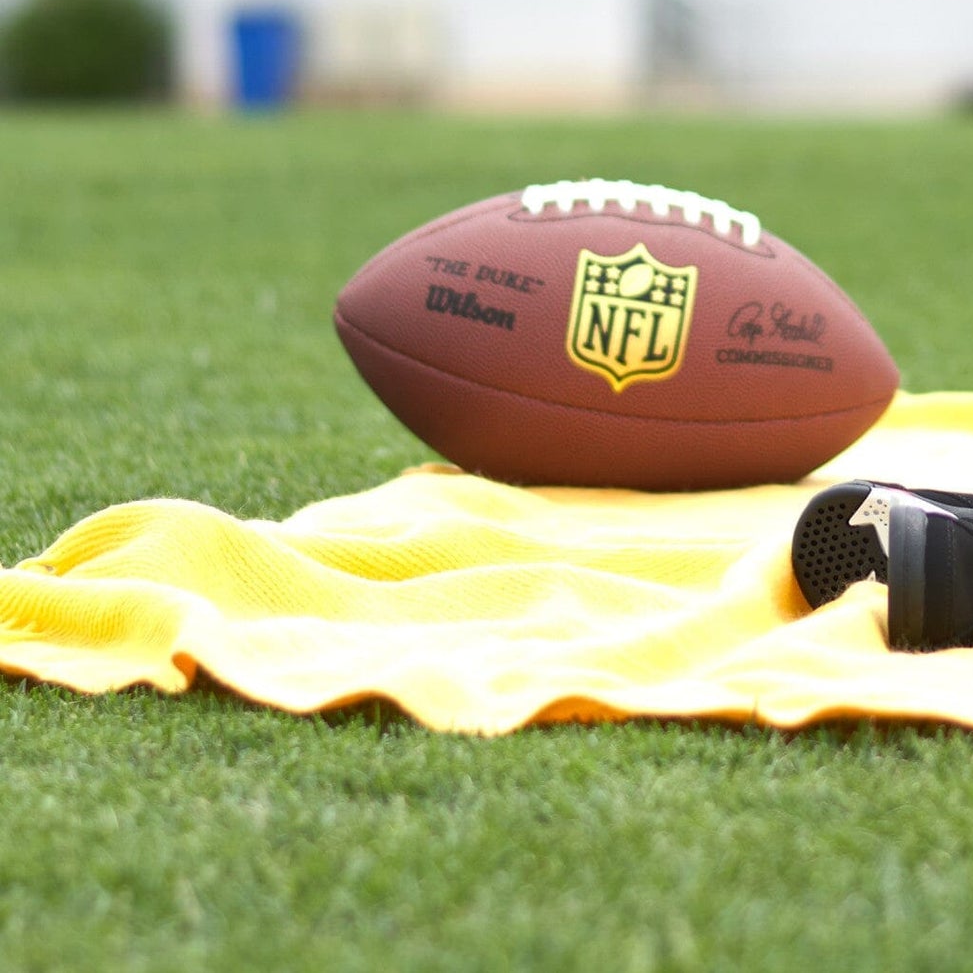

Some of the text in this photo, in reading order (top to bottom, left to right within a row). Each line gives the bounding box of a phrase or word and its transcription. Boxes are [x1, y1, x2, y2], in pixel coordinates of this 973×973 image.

[426, 284, 515, 331] Wilson
[582, 301, 669, 366] NFL
[716, 349, 833, 371] COMMISSIONER
